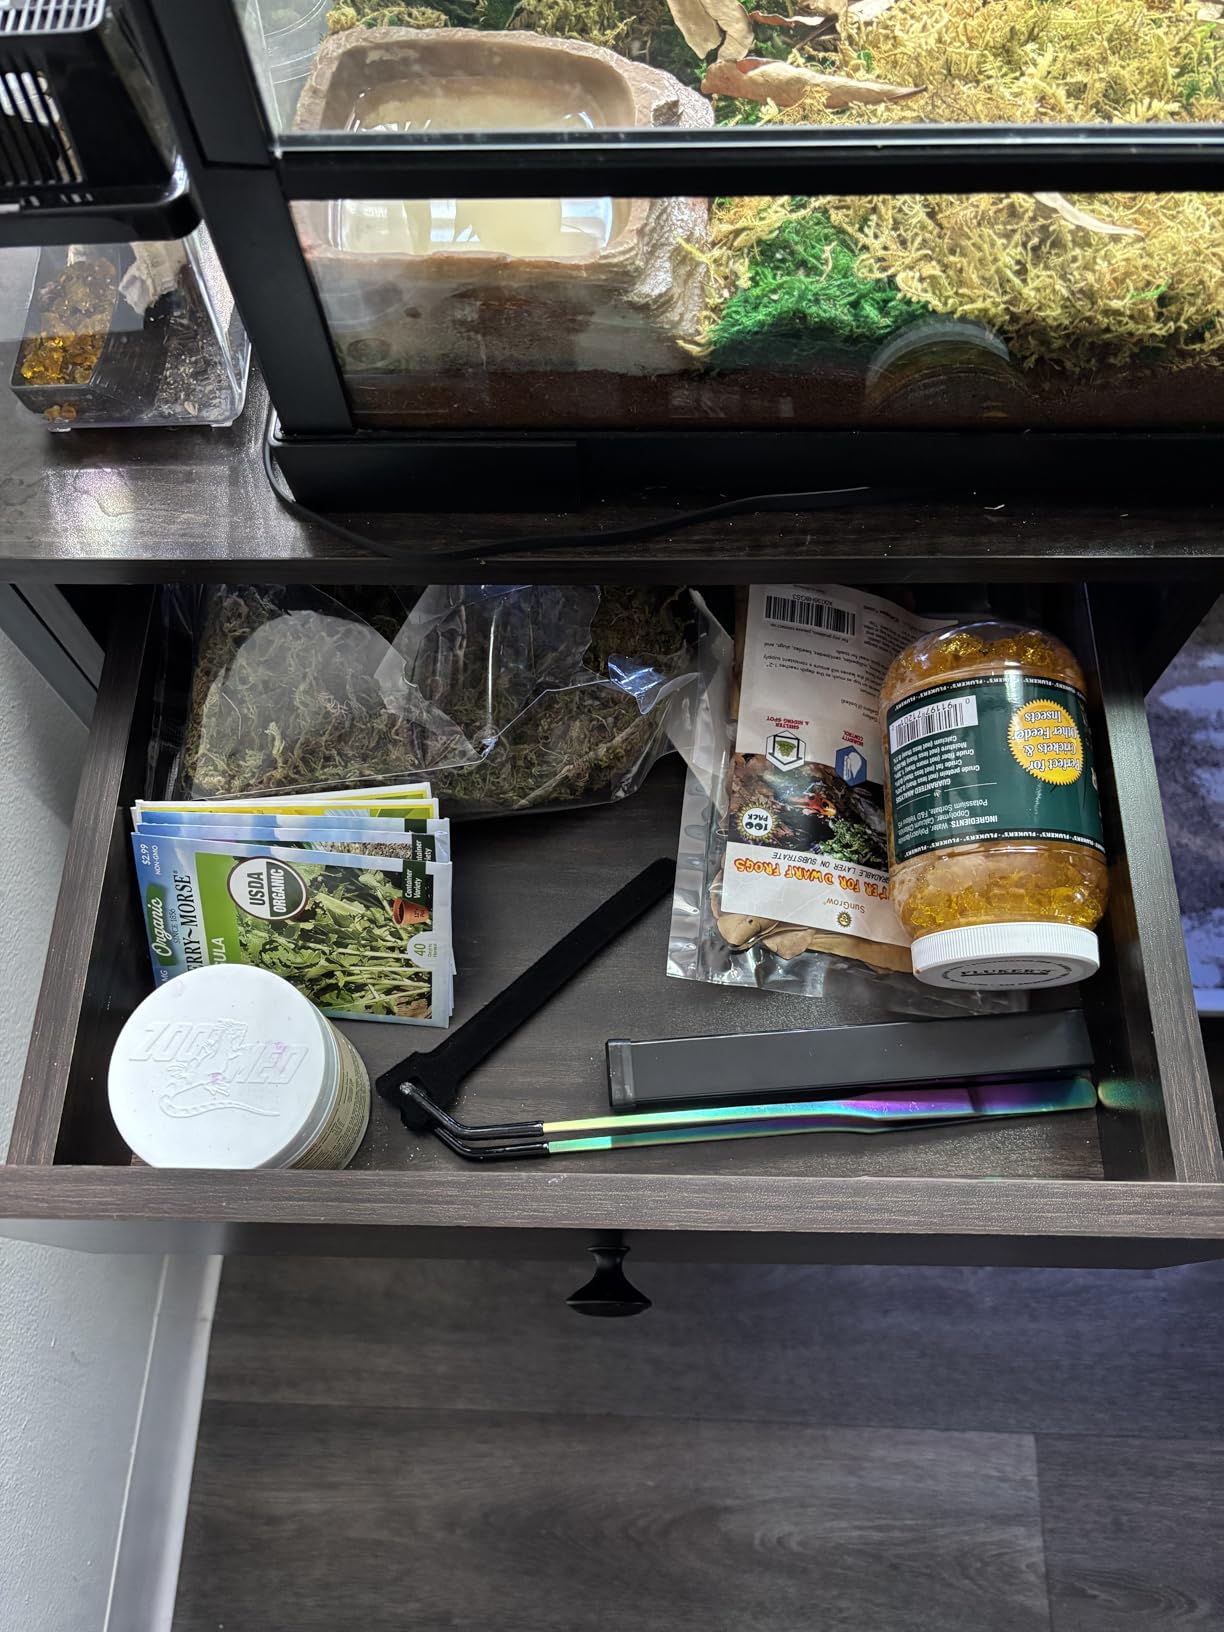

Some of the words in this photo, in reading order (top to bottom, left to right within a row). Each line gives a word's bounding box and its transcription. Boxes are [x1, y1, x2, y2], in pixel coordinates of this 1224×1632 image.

[952, 680, 982, 689] FLUKER'S
[919, 686, 946, 698] FLUKER'S
[925, 702, 952, 716] 91197
[1024, 711, 1062, 723] Insects
[1012, 727, 1050, 741] Feeder
[1052, 727, 1076, 738] Other
[934, 736, 957, 745] Calcium
[941, 742, 967, 751] Moisture
[956, 748, 974, 757] Crude
[1024, 745, 1034, 756] &
[1038, 742, 1076, 755] Crickets
[944, 759, 962, 768] Crude
[961, 764, 980, 773] Crude
[1027, 760, 1045, 772] for
[1048, 759, 1080, 771] Perfect
[940, 767, 960, 777] protein
[914, 778, 950, 794] GUARANTEED
[954, 799, 988, 809] Potassium
[745, 822, 768, 831] 100
[931, 838, 959, 848] FLUKER'S
[966, 833, 998, 841] FLUKER'S
[140, 844, 151, 866] $2.99
[152, 845, 162, 875] NON-GMO
[771, 852, 817, 866] SUBSTRATE
[734, 859, 780, 876] FROGS
[820, 860, 830, 868] ON
[833, 863, 856, 874] LAYER
[785, 865, 833, 885] DWARF
[247, 872, 265, 905] USDA
[413, 878, 422, 898] Variety
[838, 875, 860, 893] FOR
[270, 869, 286, 912] ORGANIC
[864, 881, 889, 900] TER
[826, 898, 865, 913] SunGrow
[148, 897, 172, 956] Organic
[212, 938, 226, 964] ULA
[414, 944, 426, 956] 40
